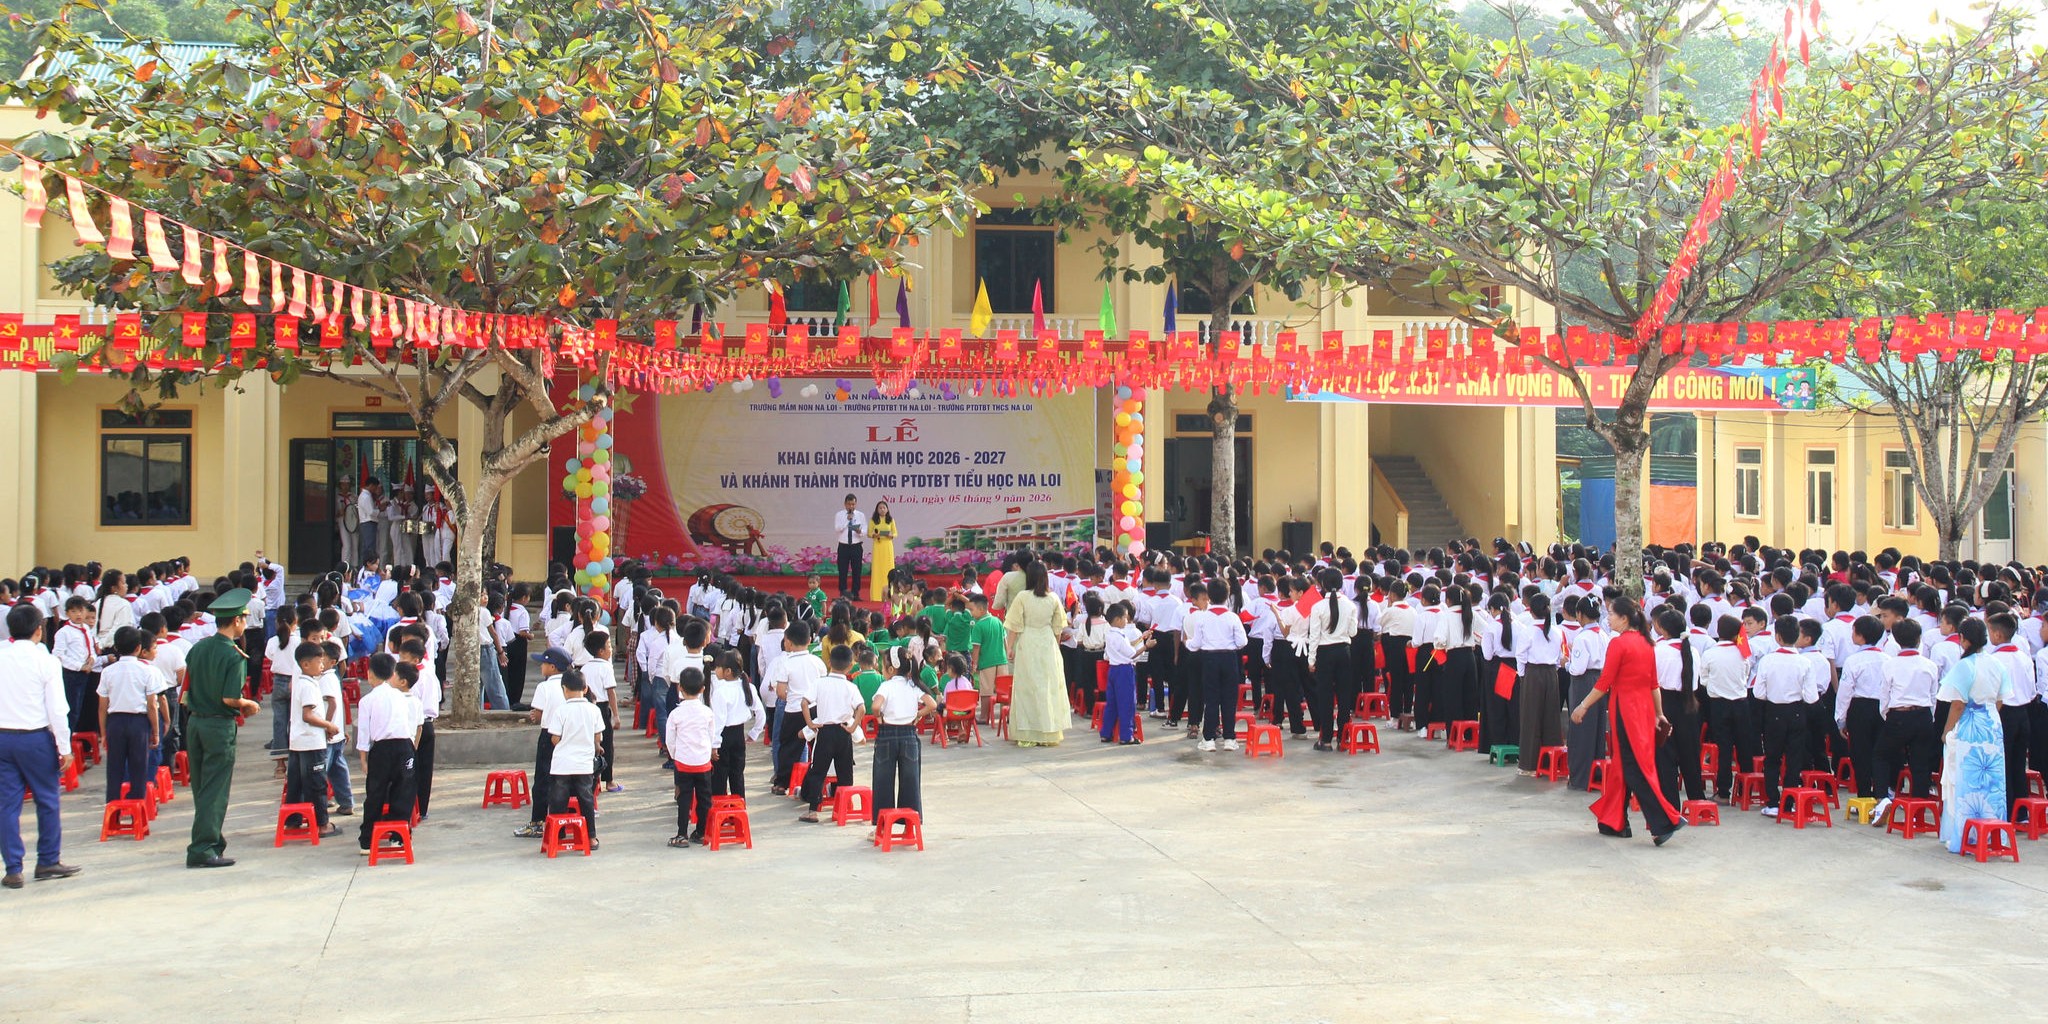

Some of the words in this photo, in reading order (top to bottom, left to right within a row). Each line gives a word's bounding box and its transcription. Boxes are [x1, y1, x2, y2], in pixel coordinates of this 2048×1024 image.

[1505, 373, 1552, 402] VỌNG
[1674, 370, 1723, 400] CÔNG
[1729, 371, 1764, 400] MỚI
[866, 418, 920, 442] LỄ
[778, 451, 810, 465] KHAI
[814, 447, 856, 465] GIẢNG
[860, 448, 893, 465] NĂM
[897, 452, 924, 468] HỌC
[928, 451, 960, 465] 2026
[974, 451, 1007, 465] 2027
[720, 472, 738, 488] VÀ
[742, 472, 790, 489] KHÁNH
[794, 472, 839, 488] THÀNH
[843, 471, 897, 488] TRƯỜNG
[901, 474, 951, 488] PTDTBT
[954, 469, 983, 488] TIỂU
[987, 474, 1015, 490] HỌC
[1018, 474, 1036, 487] NA
[1041, 474, 1061, 487] LOI
[882, 495, 896, 503] Na
[899, 494, 918, 504] Loi,
[922, 494, 945, 505] ngày
[949, 495, 961, 503] 05
[963, 494, 992, 504] tháng
[995, 494, 1001, 502] 9
[1004, 494, 1025, 503] năm
[1028, 494, 1052, 502] 2026
